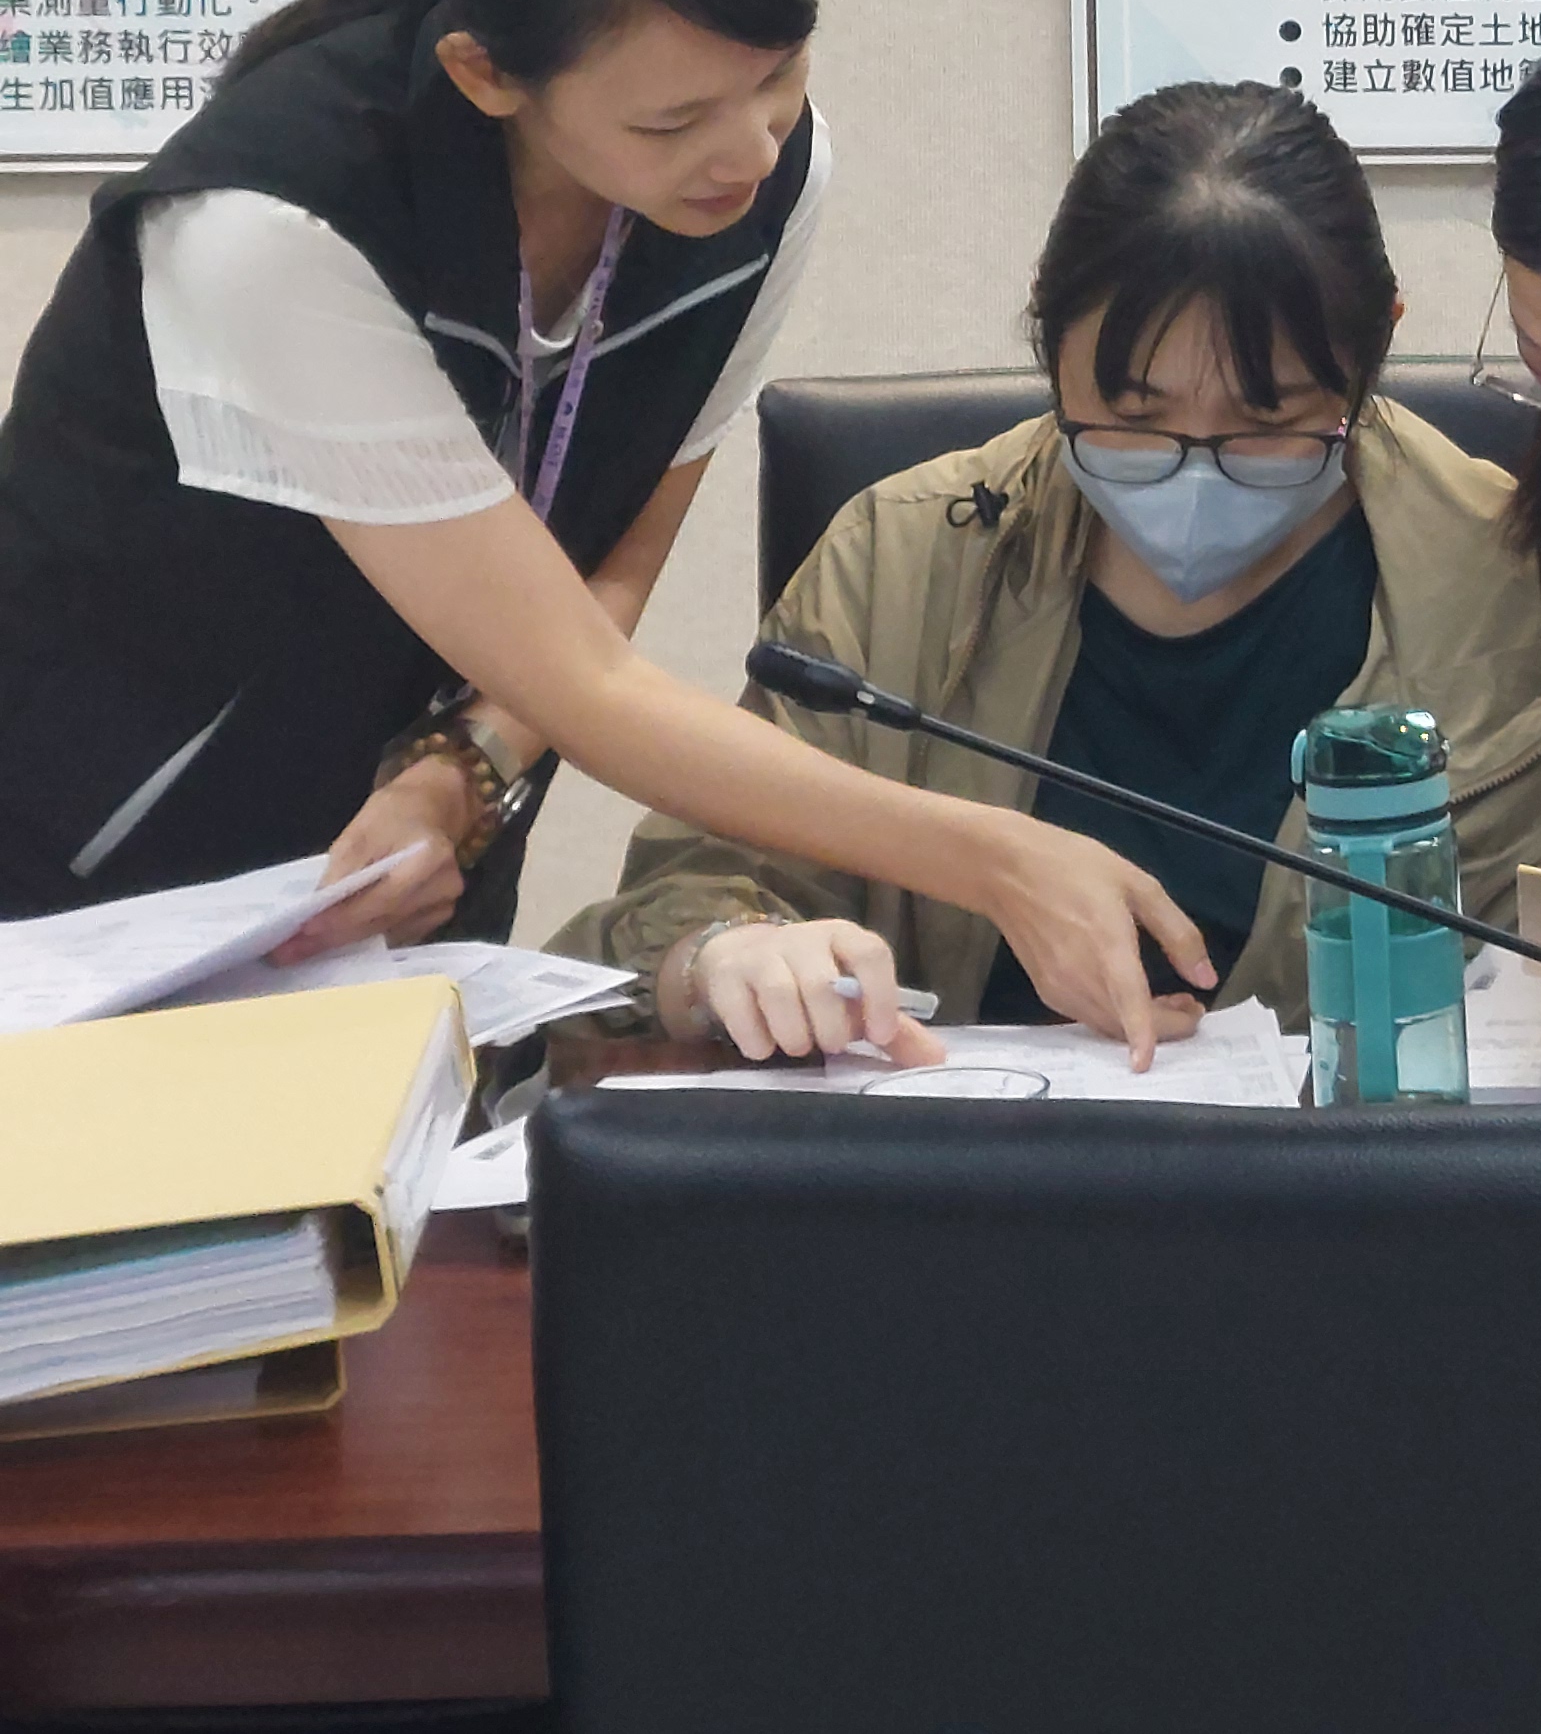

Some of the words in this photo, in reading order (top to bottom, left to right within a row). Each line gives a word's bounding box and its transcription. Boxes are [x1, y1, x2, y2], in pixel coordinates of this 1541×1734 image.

[0, 30, 248, 65] 繪業務執行效
[0, 75, 220, 112] 生加值應用
[1321, 56, 1530, 94] 建立數值地
